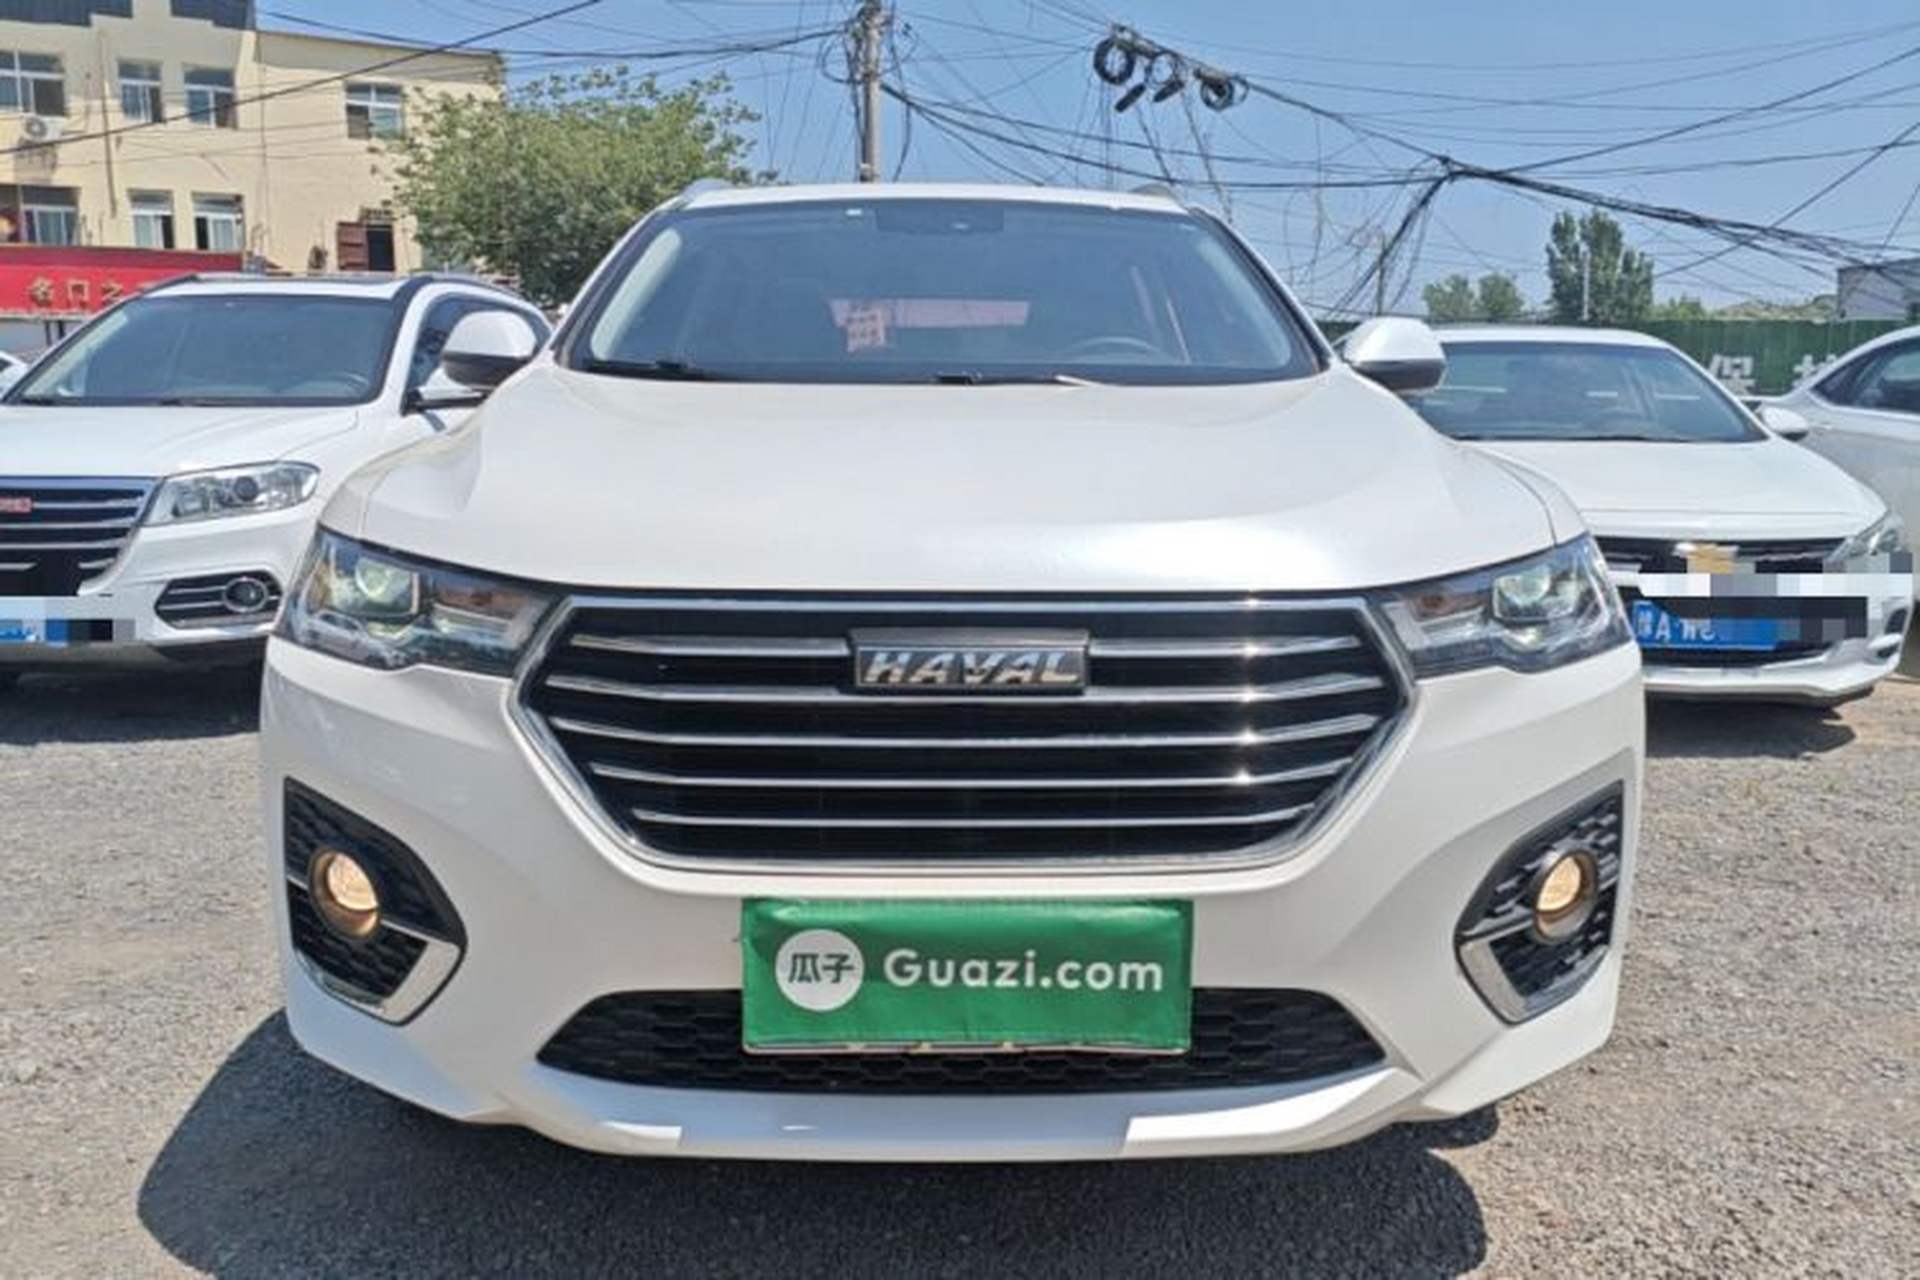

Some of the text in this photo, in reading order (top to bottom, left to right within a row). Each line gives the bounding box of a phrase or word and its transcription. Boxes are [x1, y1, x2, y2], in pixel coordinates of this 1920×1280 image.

[864, 652, 1078, 684] HAVAL
[787, 952, 855, 985] 瓜子
[883, 949, 1163, 992] Guazi.com
